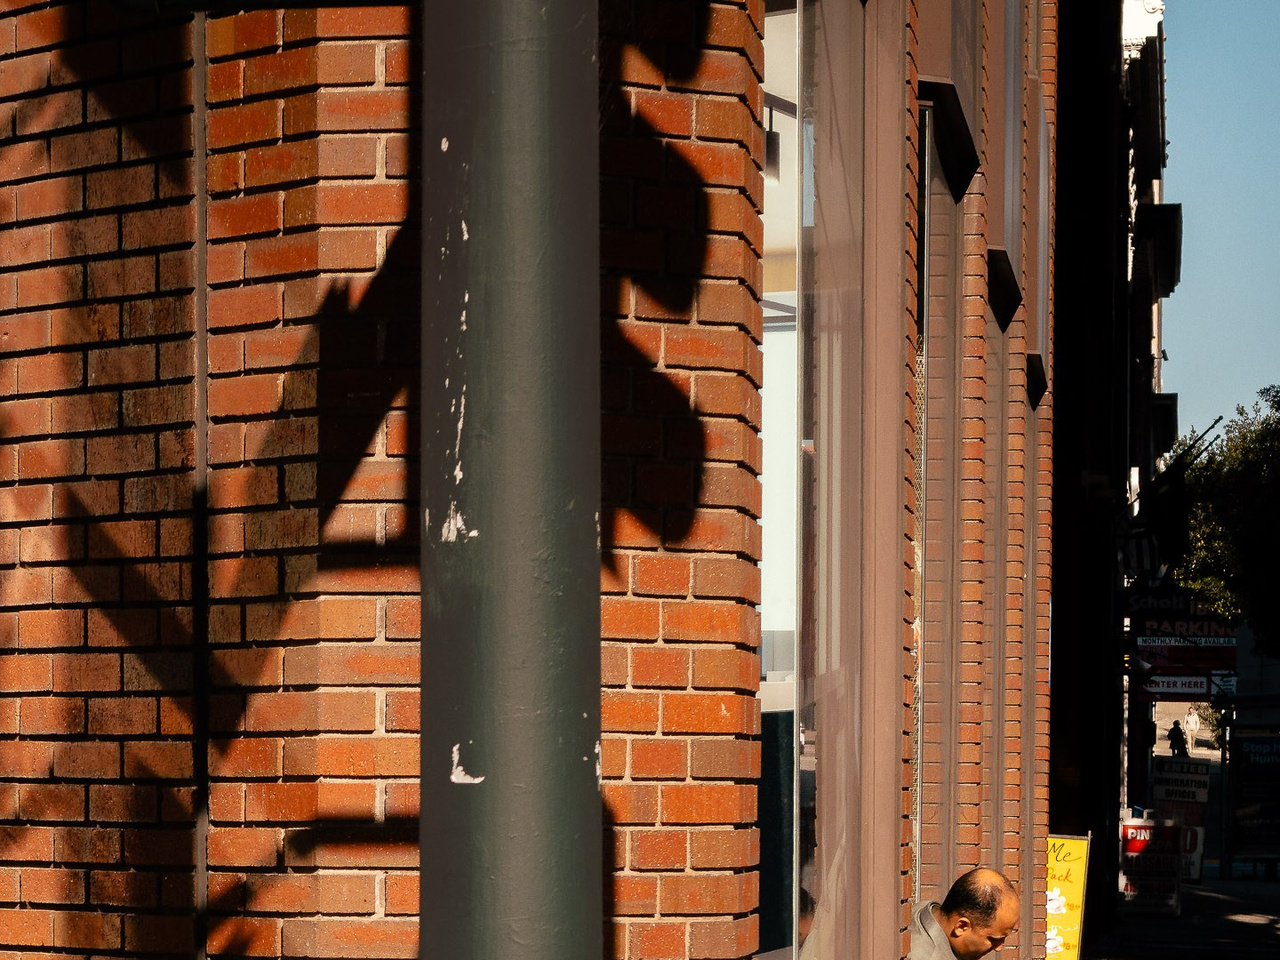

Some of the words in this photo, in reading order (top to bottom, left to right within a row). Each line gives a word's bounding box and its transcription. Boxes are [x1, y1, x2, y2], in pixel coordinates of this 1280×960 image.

[1203, 638, 1237, 646] AVAILABL
[1181, 680, 1205, 689] HERE
[1242, 741, 1271, 754] Stop
[1250, 753, 1280, 764] Hum
[1153, 776, 1208, 789] IMMIGRATION
[1165, 789, 1197, 800] OFFICES
[1048, 842, 1082, 862] Me
